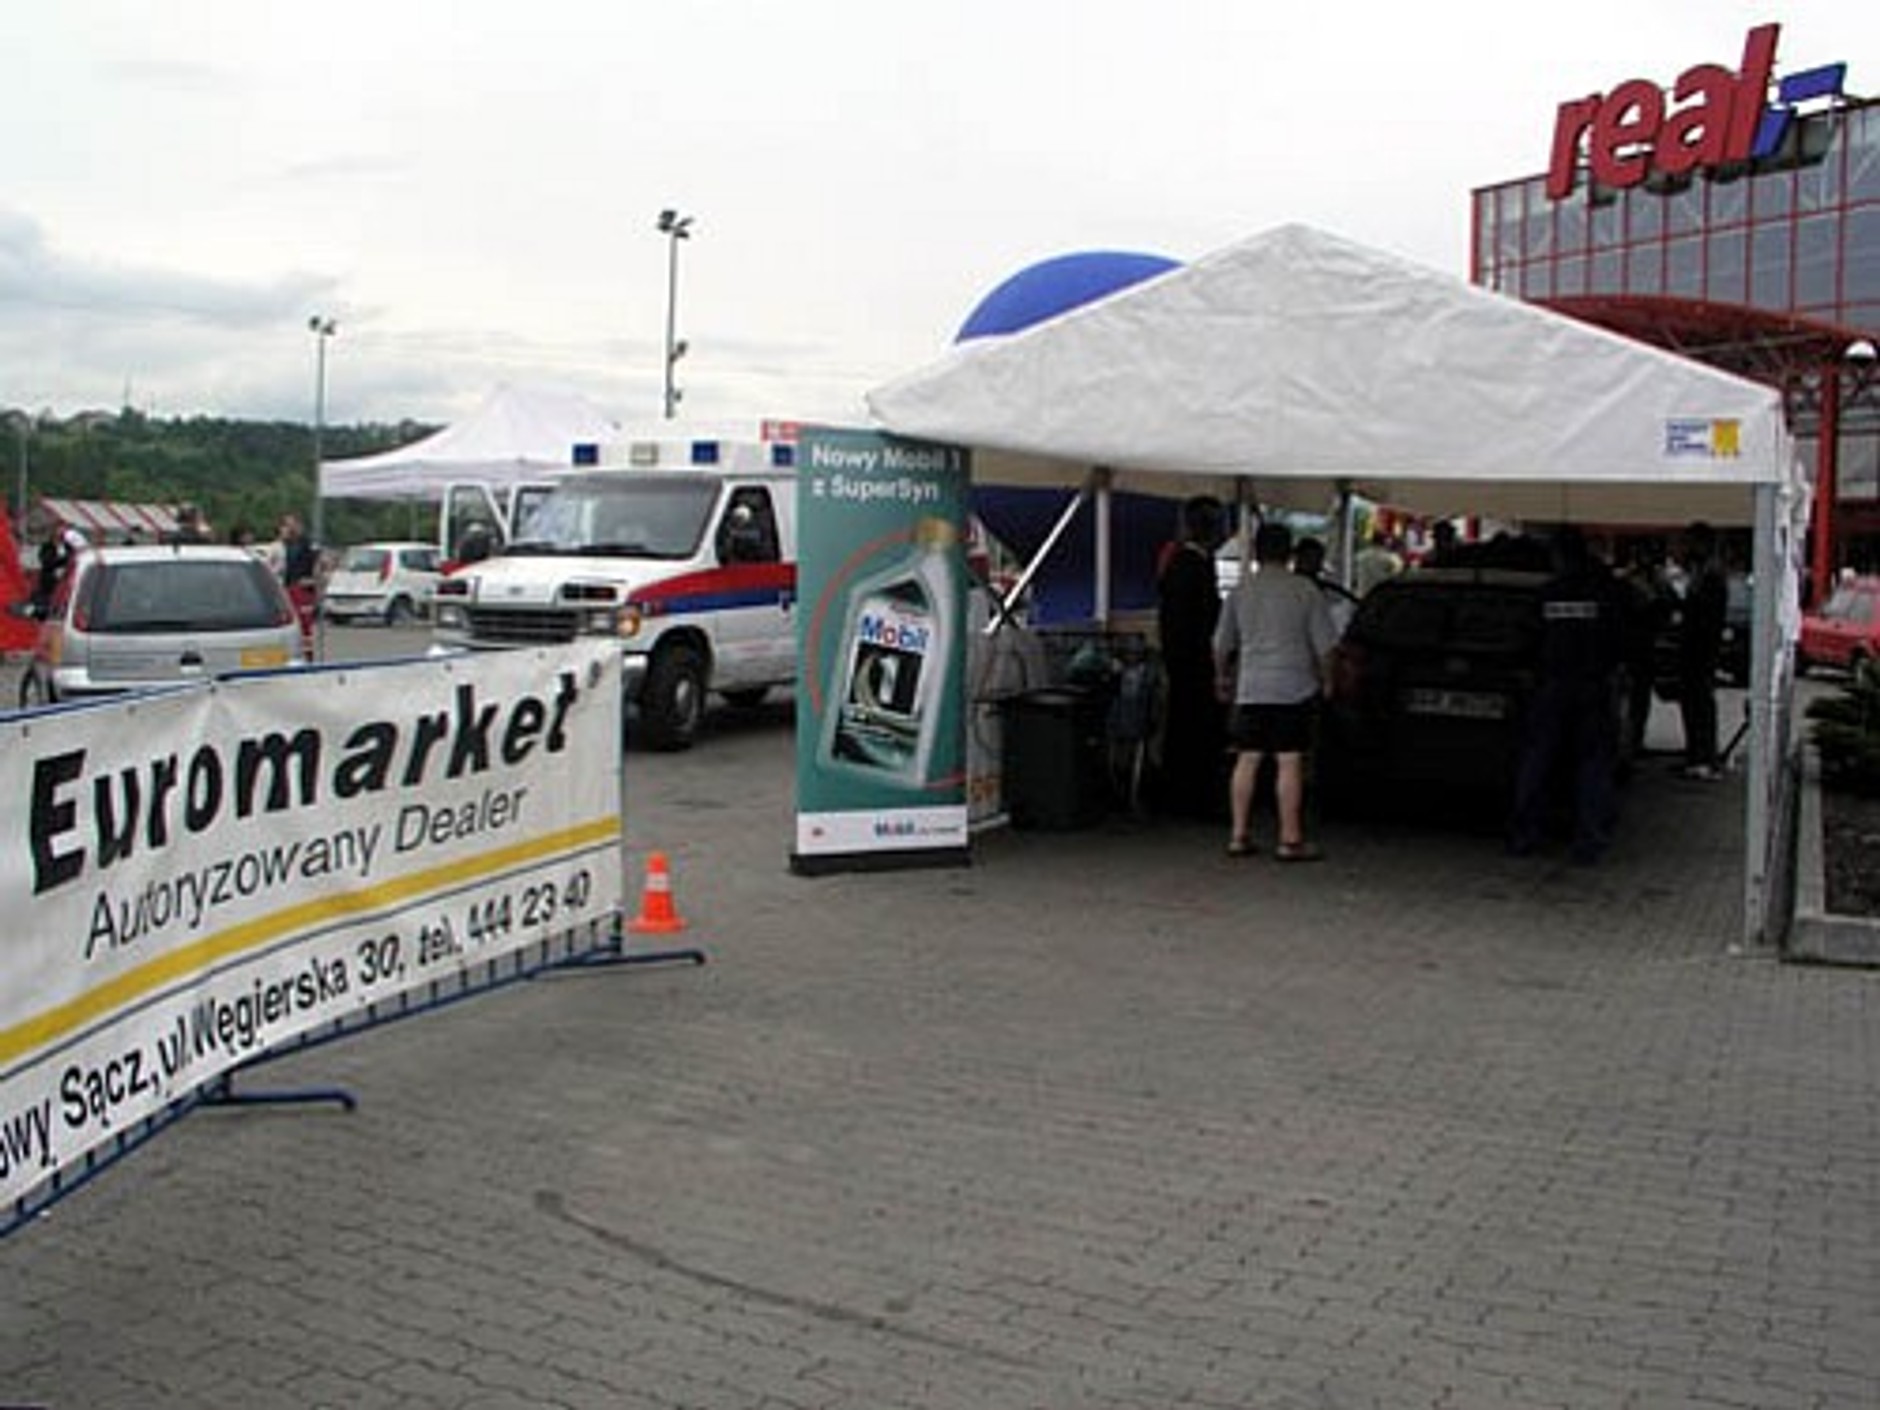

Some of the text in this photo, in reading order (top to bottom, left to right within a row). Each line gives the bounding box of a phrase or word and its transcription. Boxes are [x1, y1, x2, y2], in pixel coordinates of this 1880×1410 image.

[811, 443, 877, 471] Nowy
[883, 446, 946, 470] Mobil
[830, 475, 940, 502] SuperSyn
[861, 613, 930, 649] Mobil
[29, 671, 578, 896] Euromarket
[85, 786, 527, 959] Autoryzowany Dealer
[521, 882, 557, 928] 23
[563, 867, 591, 908] 40
